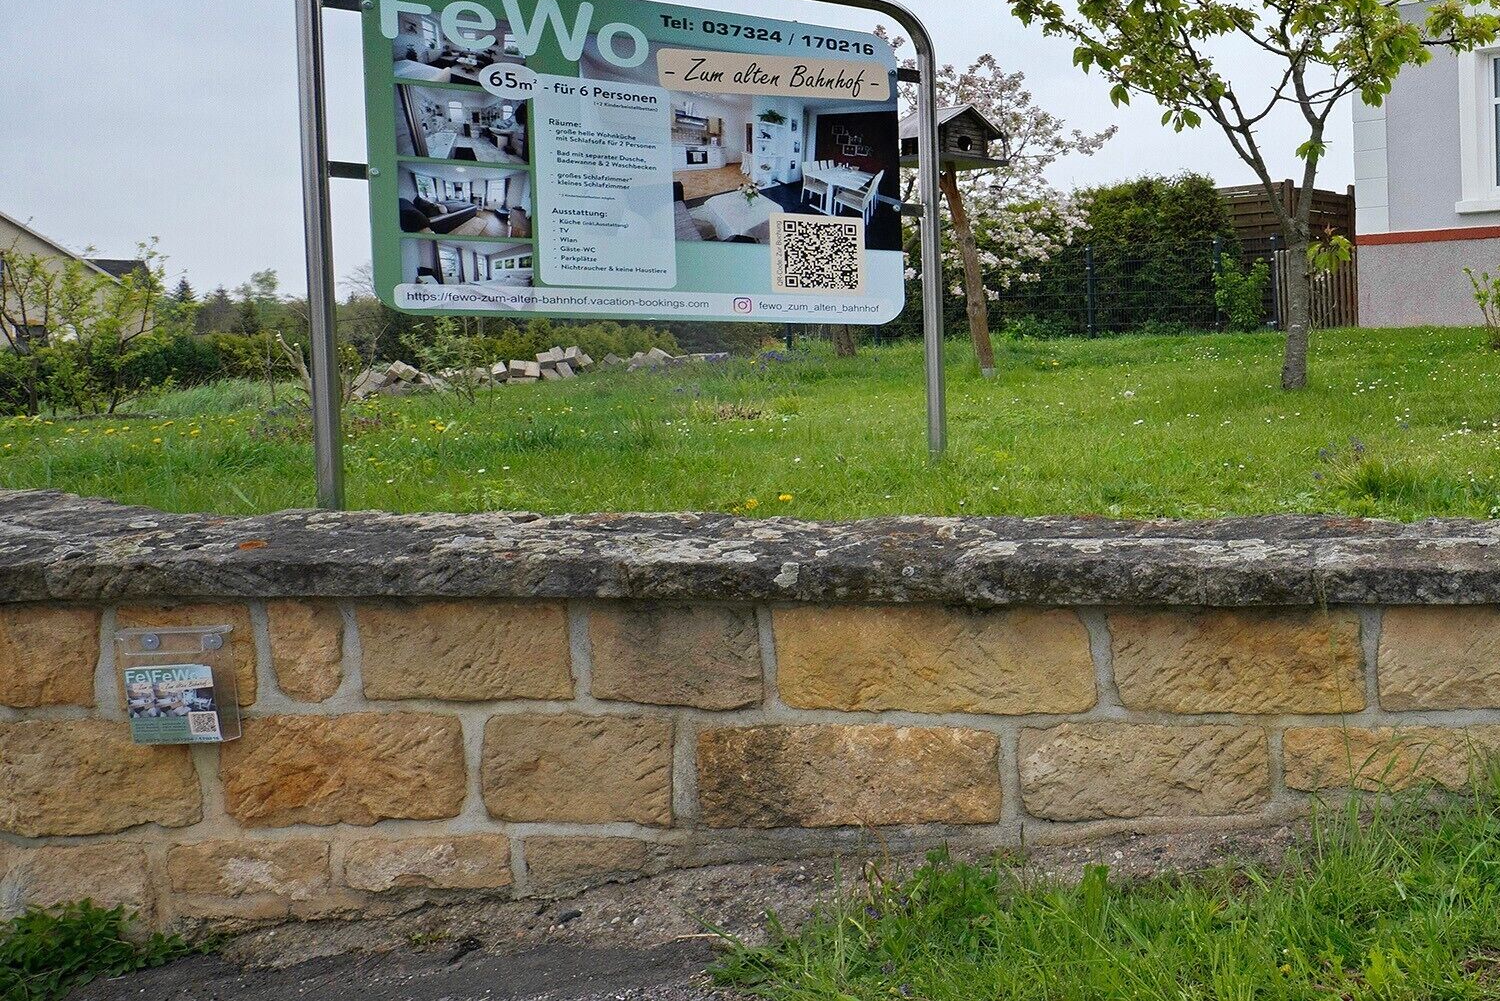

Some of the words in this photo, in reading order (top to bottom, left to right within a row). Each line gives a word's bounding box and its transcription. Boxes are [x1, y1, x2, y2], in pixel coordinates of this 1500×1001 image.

[659, 14, 694, 31] Tel:
[702, 20, 782, 43] 037324
[801, 35, 874, 55] 170216
[684, 58, 724, 82] Zum
[733, 62, 780, 87] alten
[789, 65, 865, 97] Bahnhof
[554, 83, 575, 95] für
[580, 85, 589, 96] 6
[593, 87, 657, 104] Personen
[548, 118, 582, 128] Räume:
[555, 129, 576, 137] große
[578, 129, 595, 137] helle
[596, 131, 637, 141] Wohnküche
[569, 136, 606, 146] Schlafsofa
[625, 141, 657, 150] Personen
[585, 152, 618, 161] separater
[556, 157, 597, 166] Badewanne
[611, 161, 657, 171] Waschbecken
[557, 179, 582, 187] kleines
[583, 181, 631, 190] Schlafzimmer
[551, 207, 608, 219] Ausstattung:
[559, 218, 581, 226] Küche
[560, 245, 596, 253] Gäste-WC
[560, 254, 598, 263] Parkplätze
[561, 264, 607, 272] Nichtraucher
[406, 291, 710, 309] https://fewo-zum-alten-bahnhof.vacation-bookings.com
[758, 301, 880, 315] fewo_zum_alten_bahnhof
